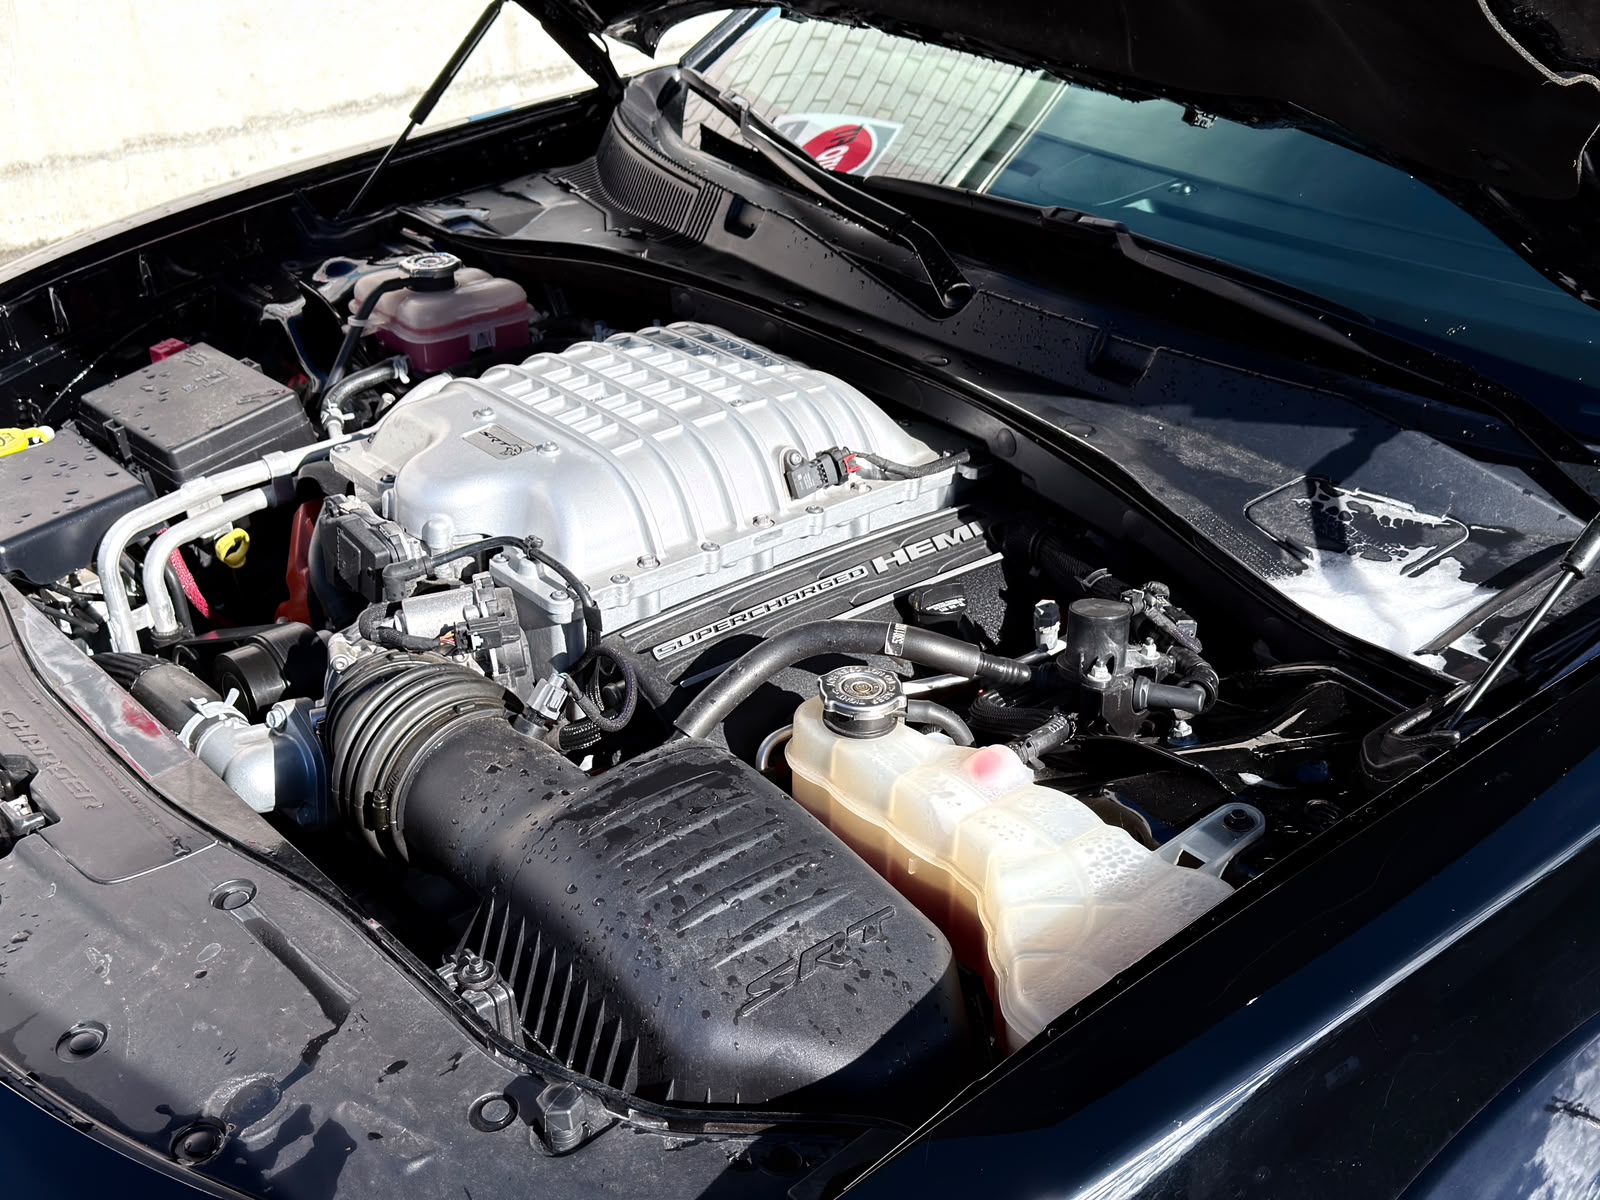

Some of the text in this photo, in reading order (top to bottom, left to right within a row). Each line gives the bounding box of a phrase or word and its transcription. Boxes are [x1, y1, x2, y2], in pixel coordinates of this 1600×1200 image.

[478, 431, 512, 447] SRT
[655, 521, 983, 655] SUPERCHARGED HEMI
[1, 709, 105, 810] CHARGER
[740, 905, 897, 1017] SRT
